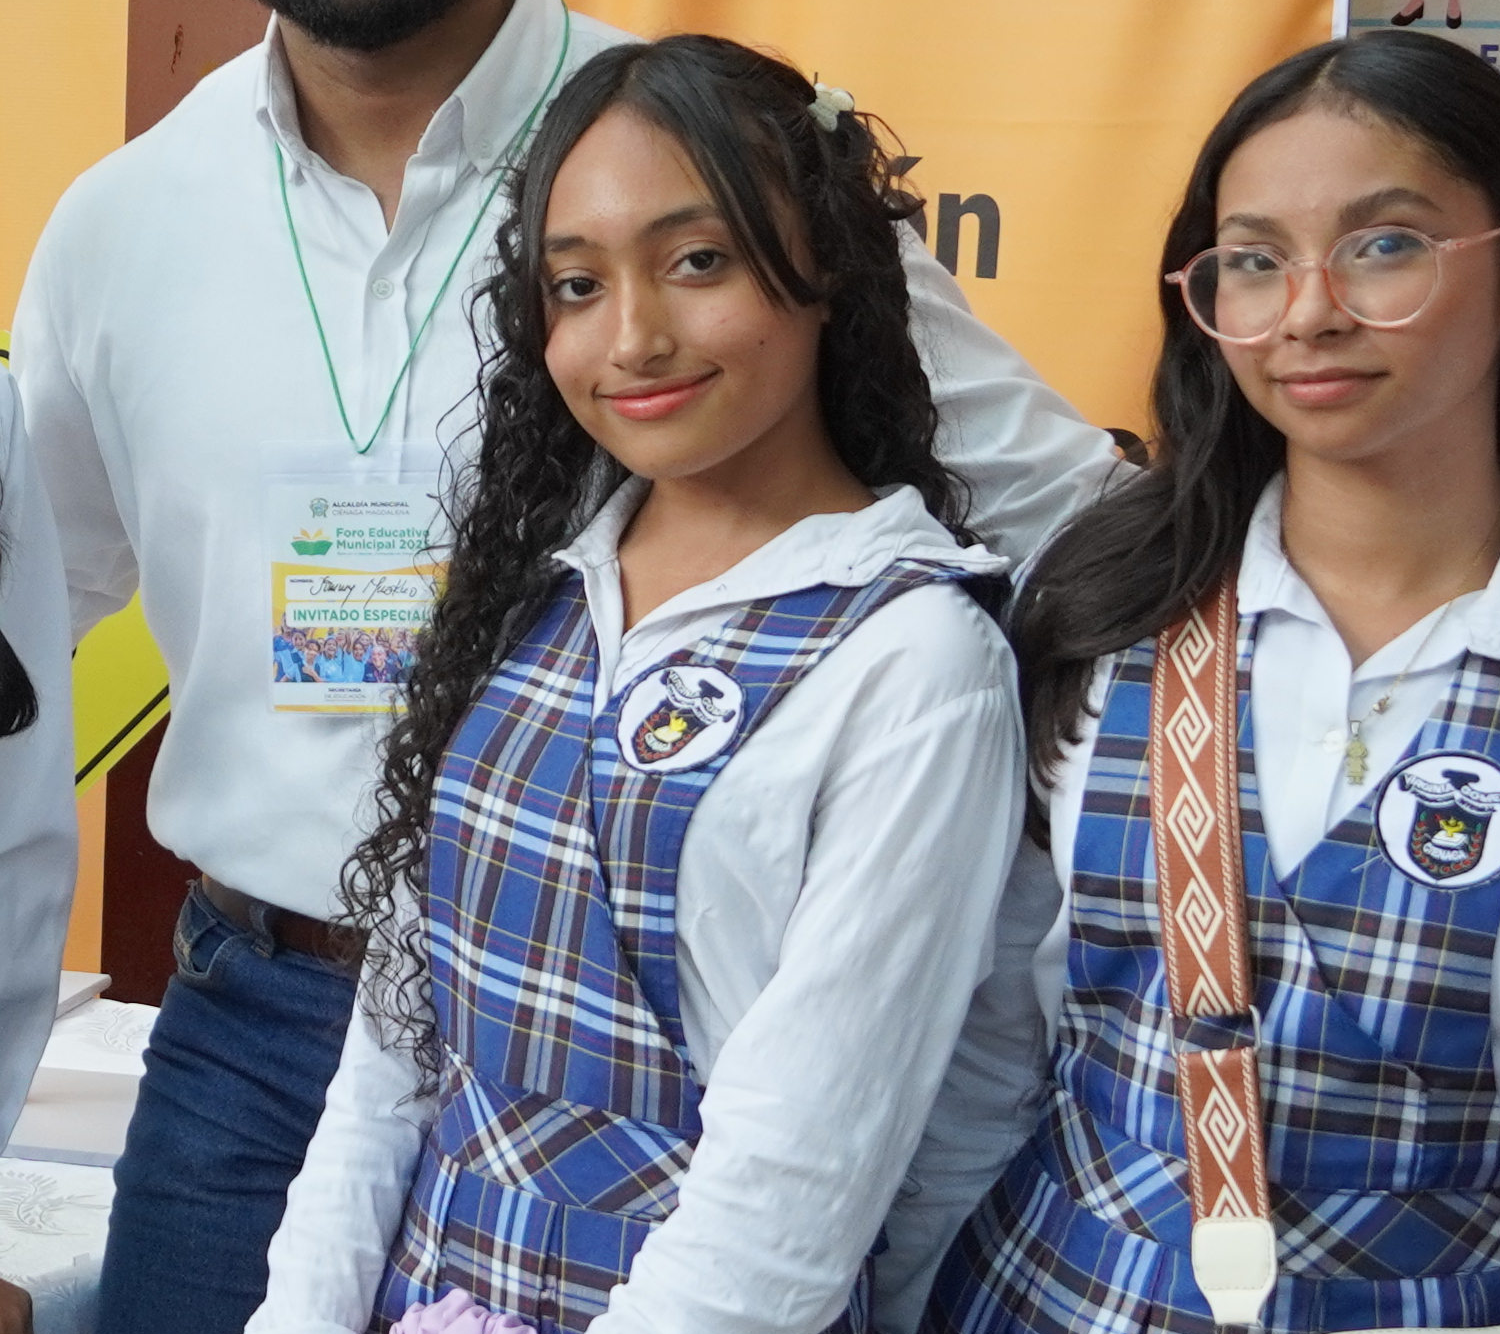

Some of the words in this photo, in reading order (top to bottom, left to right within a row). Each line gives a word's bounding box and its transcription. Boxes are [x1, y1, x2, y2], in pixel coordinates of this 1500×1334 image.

[336, 528, 364, 538] Foro
[368, 526, 430, 538] Educativo
[336, 539, 395, 553] Municipal
[293, 609, 360, 622] INVITADO
[363, 609, 430, 622] ESPECIAL
